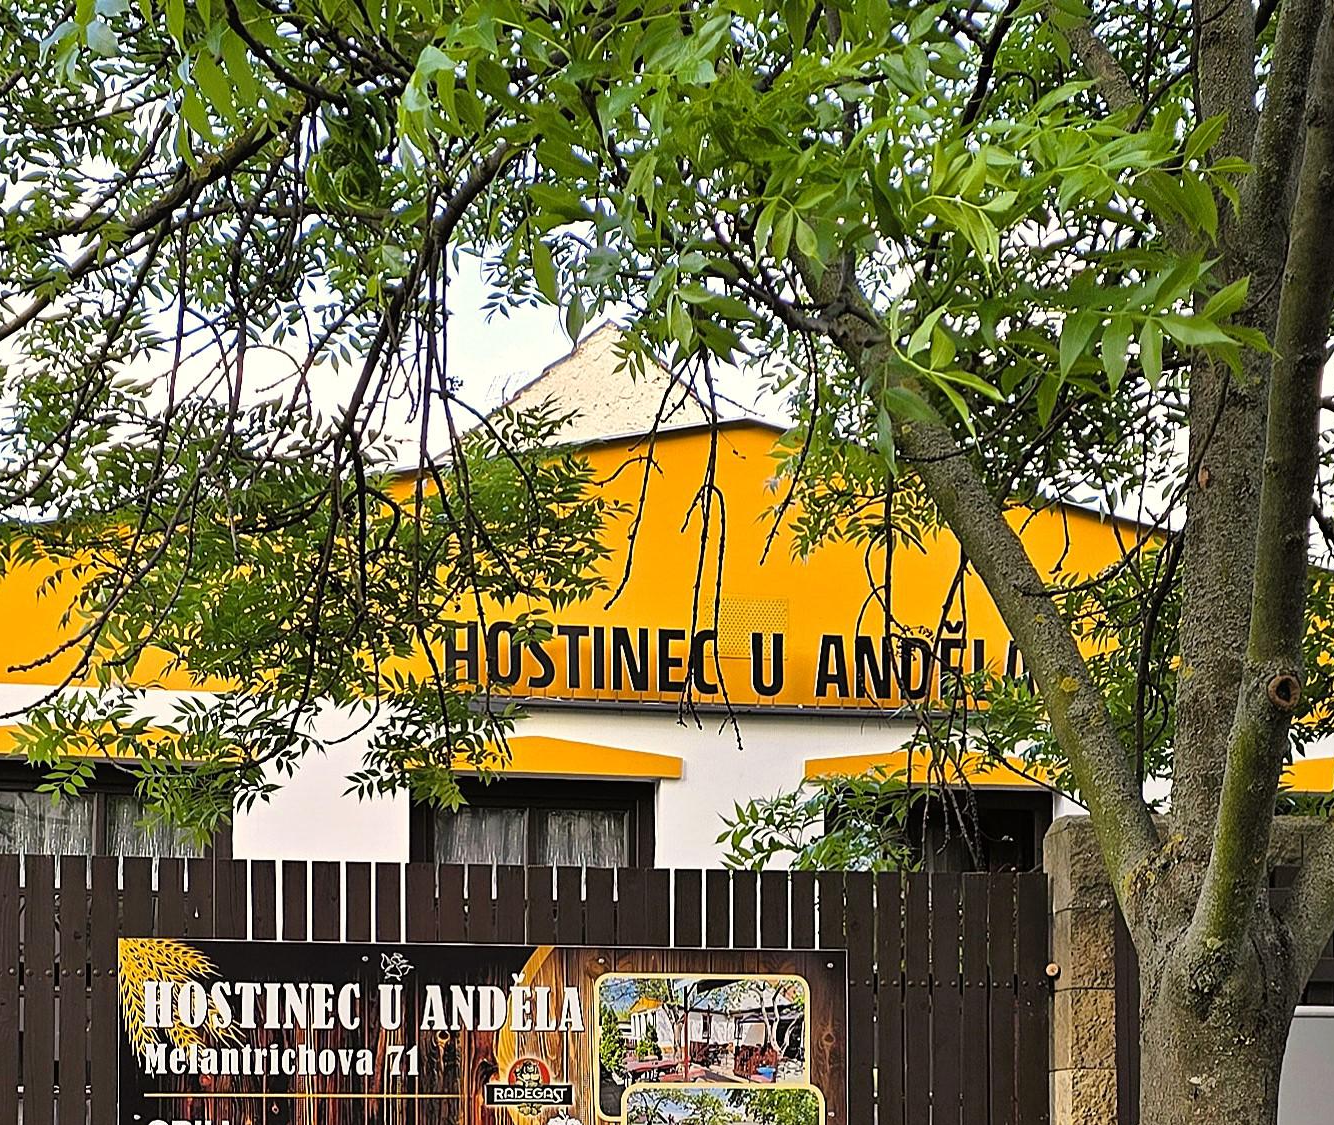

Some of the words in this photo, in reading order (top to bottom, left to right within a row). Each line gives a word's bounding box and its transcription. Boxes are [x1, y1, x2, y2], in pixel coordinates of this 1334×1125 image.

[445, 619, 718, 694] HOSTINEC
[750, 632, 784, 696] U
[144, 981, 362, 1031] HOSTINEC
[378, 984, 403, 1031] U
[420, 974, 585, 1033] ANDĚLA
[144, 1043, 374, 1078] Melantrichova
[389, 1045, 419, 1077] 71
[493, 1087, 568, 1103] RADEGAST
